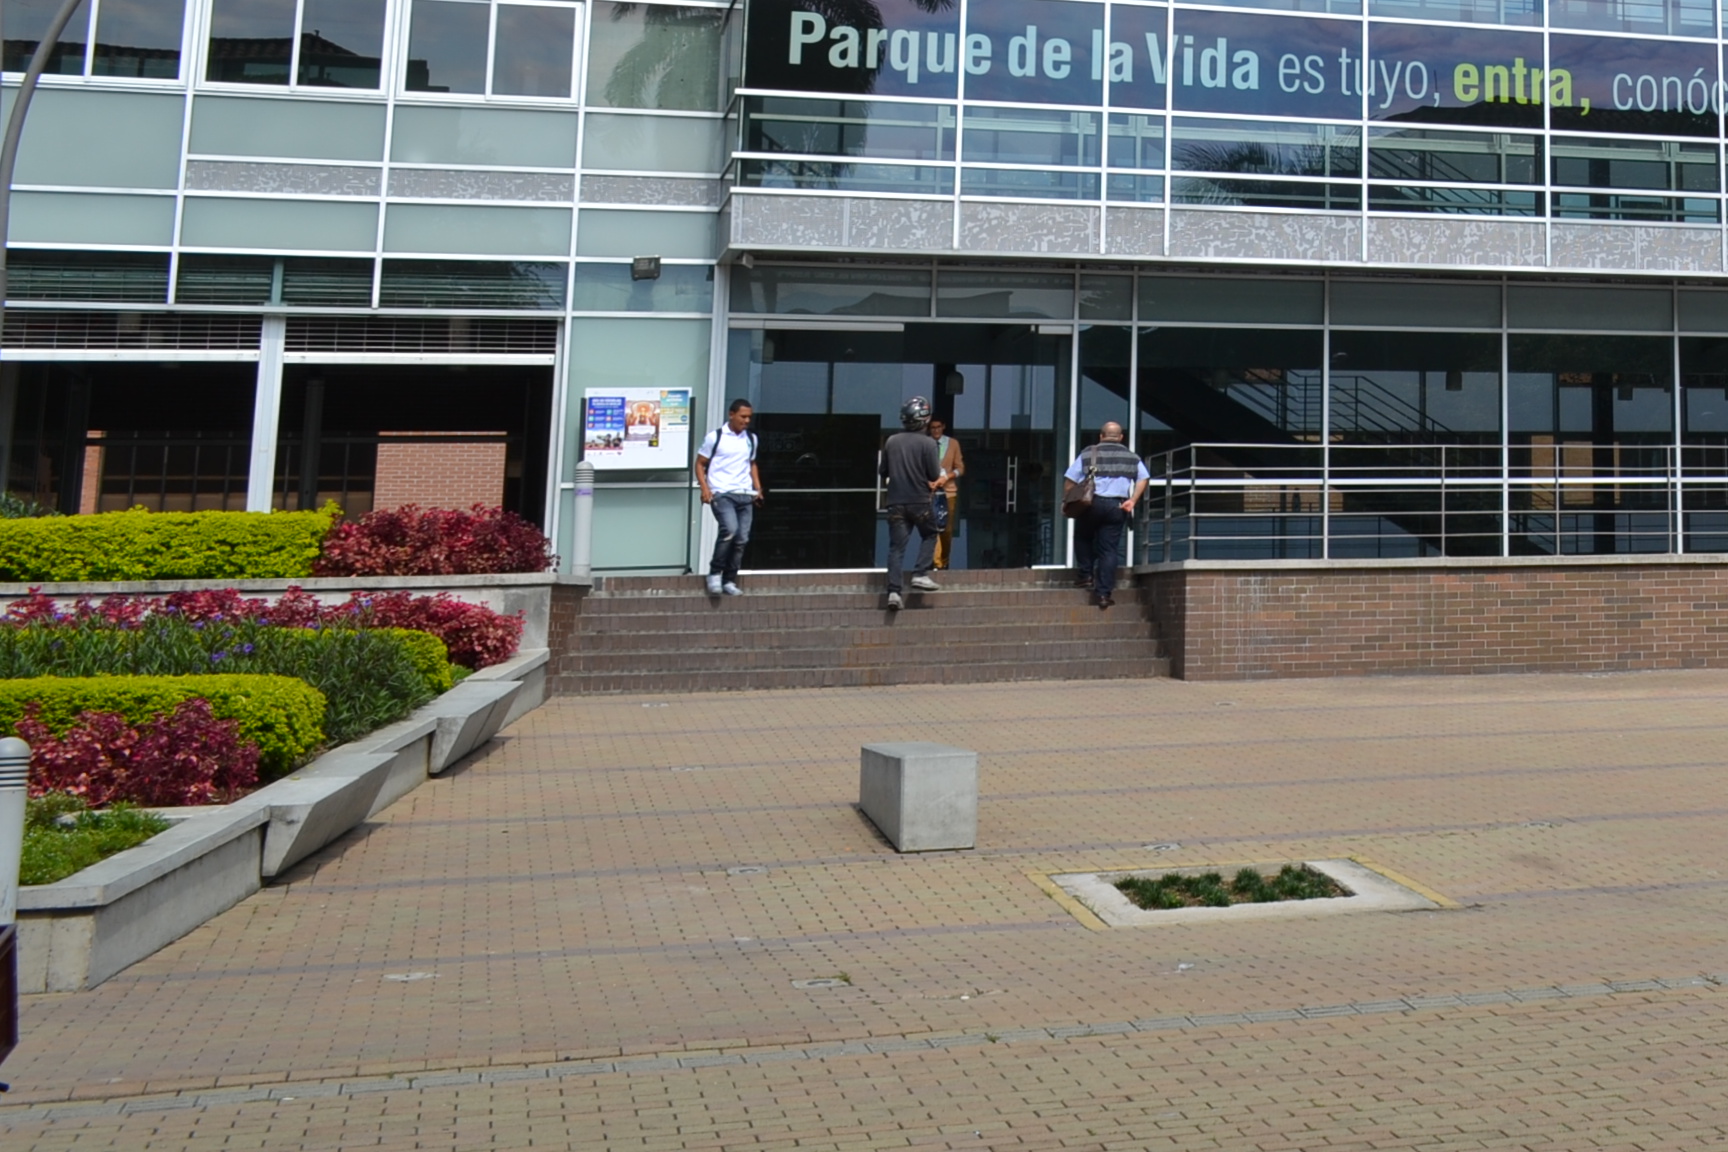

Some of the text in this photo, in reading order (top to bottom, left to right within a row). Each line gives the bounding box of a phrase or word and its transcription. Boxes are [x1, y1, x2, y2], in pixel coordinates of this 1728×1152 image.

[788, 10, 993, 84] Parque
[1007, 24, 1073, 80] de
[1090, 28, 1134, 84] la
[1144, 31, 1260, 90] Vida
[1277, 52, 1326, 94] es
[1337, 47, 1441, 109] tuyo,
[1453, 57, 1591, 116] entra,
